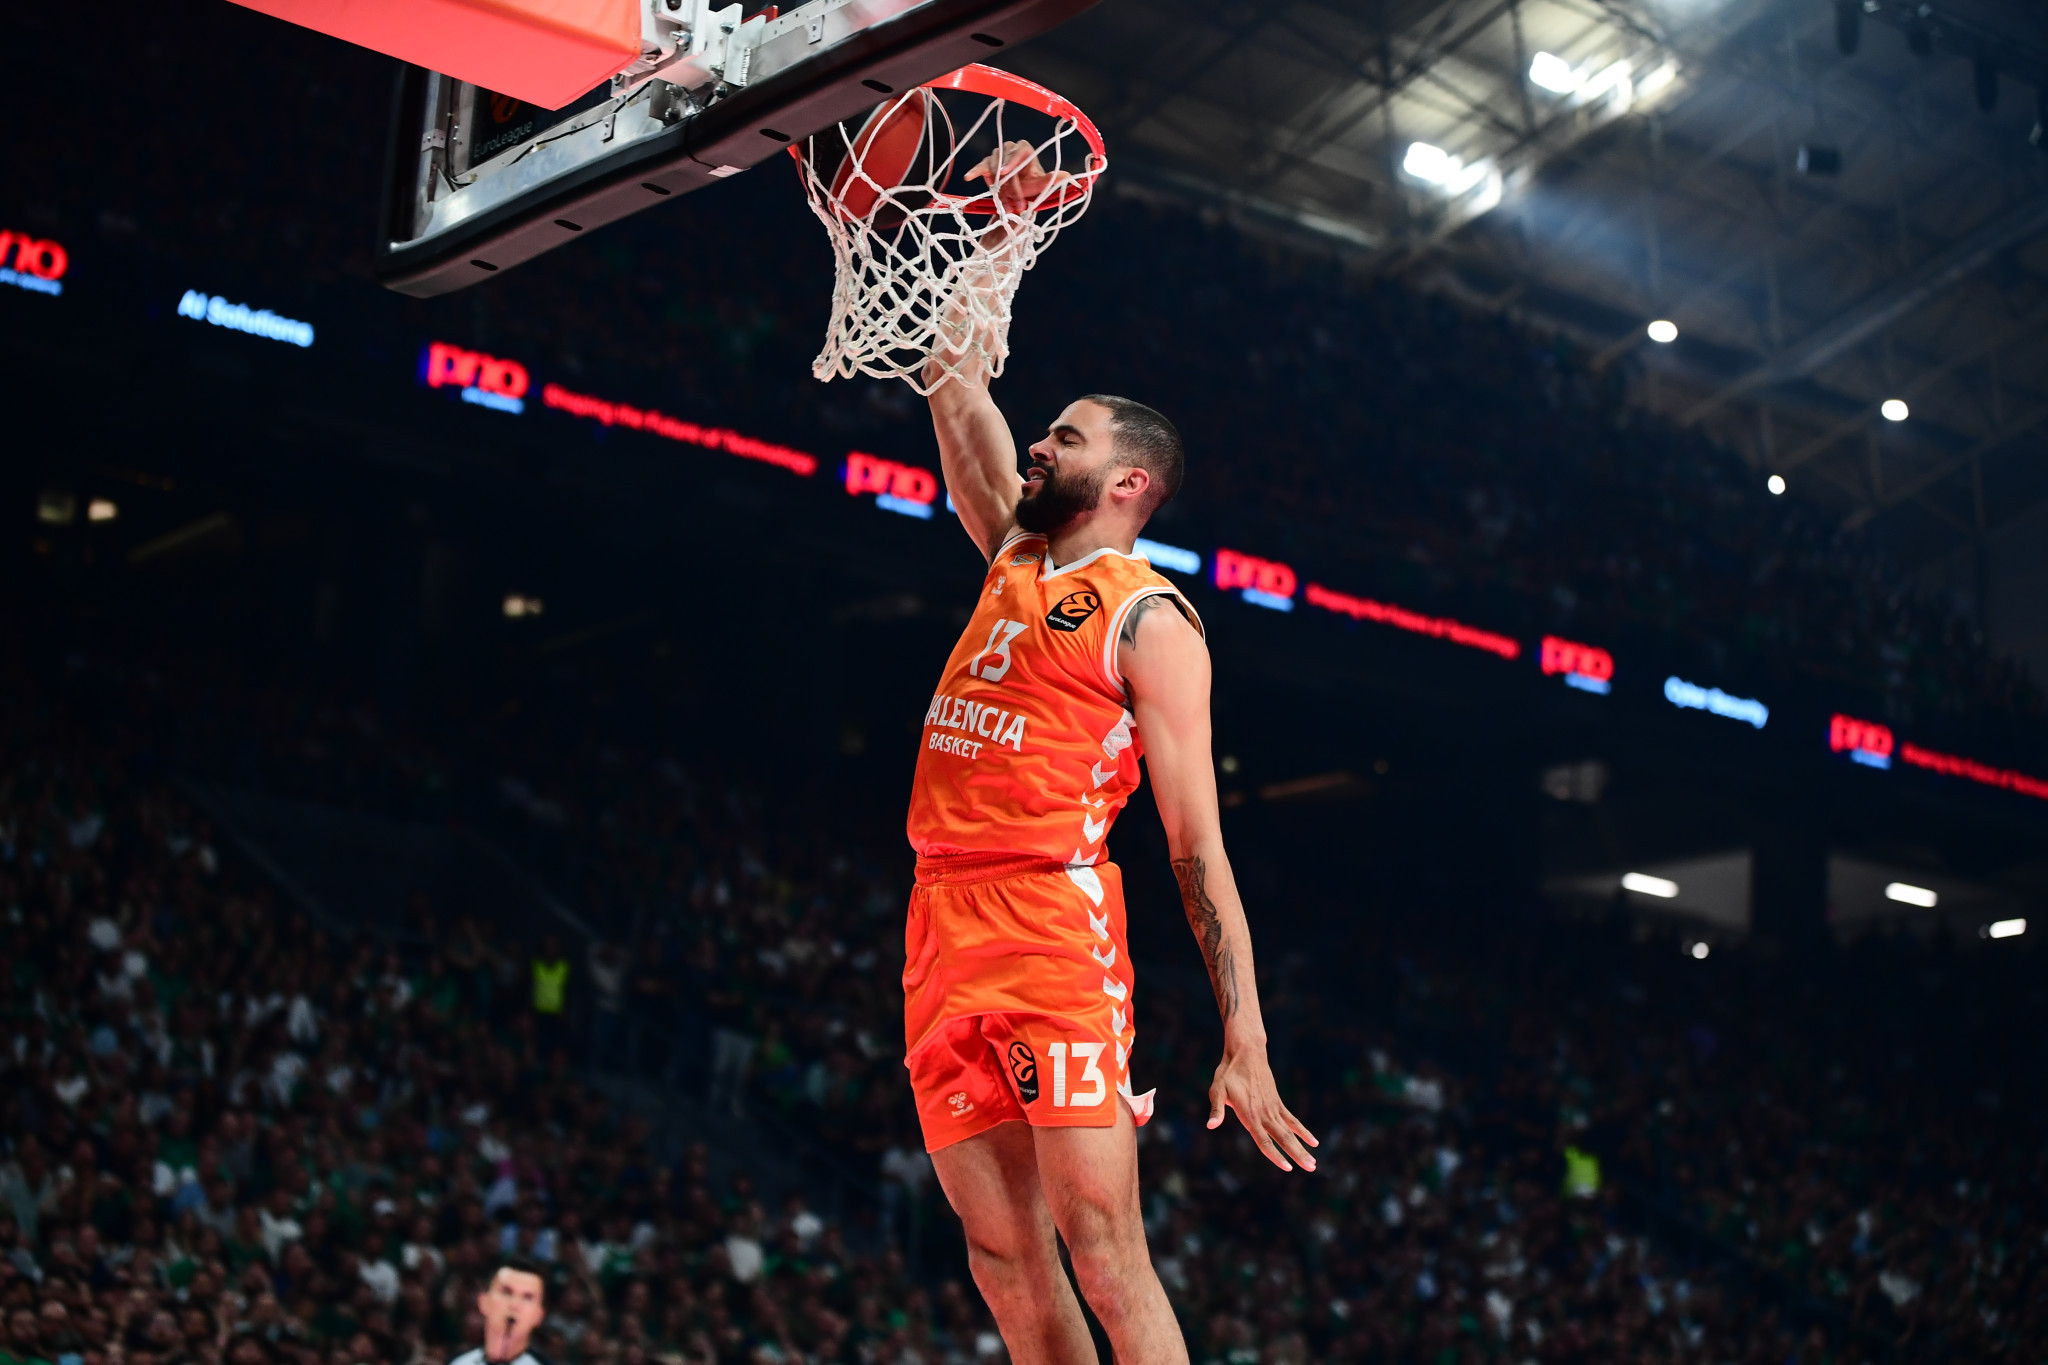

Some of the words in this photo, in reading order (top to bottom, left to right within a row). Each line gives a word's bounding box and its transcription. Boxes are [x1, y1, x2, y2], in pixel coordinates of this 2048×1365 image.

[473, 121, 534, 159] EuroLeague
[0, 230, 68, 281] no
[207, 295, 314, 348] Solutions
[970, 618, 1029, 682] 13
[928, 732, 983, 760] BASKET
[1047, 1042, 1107, 1107] 13
